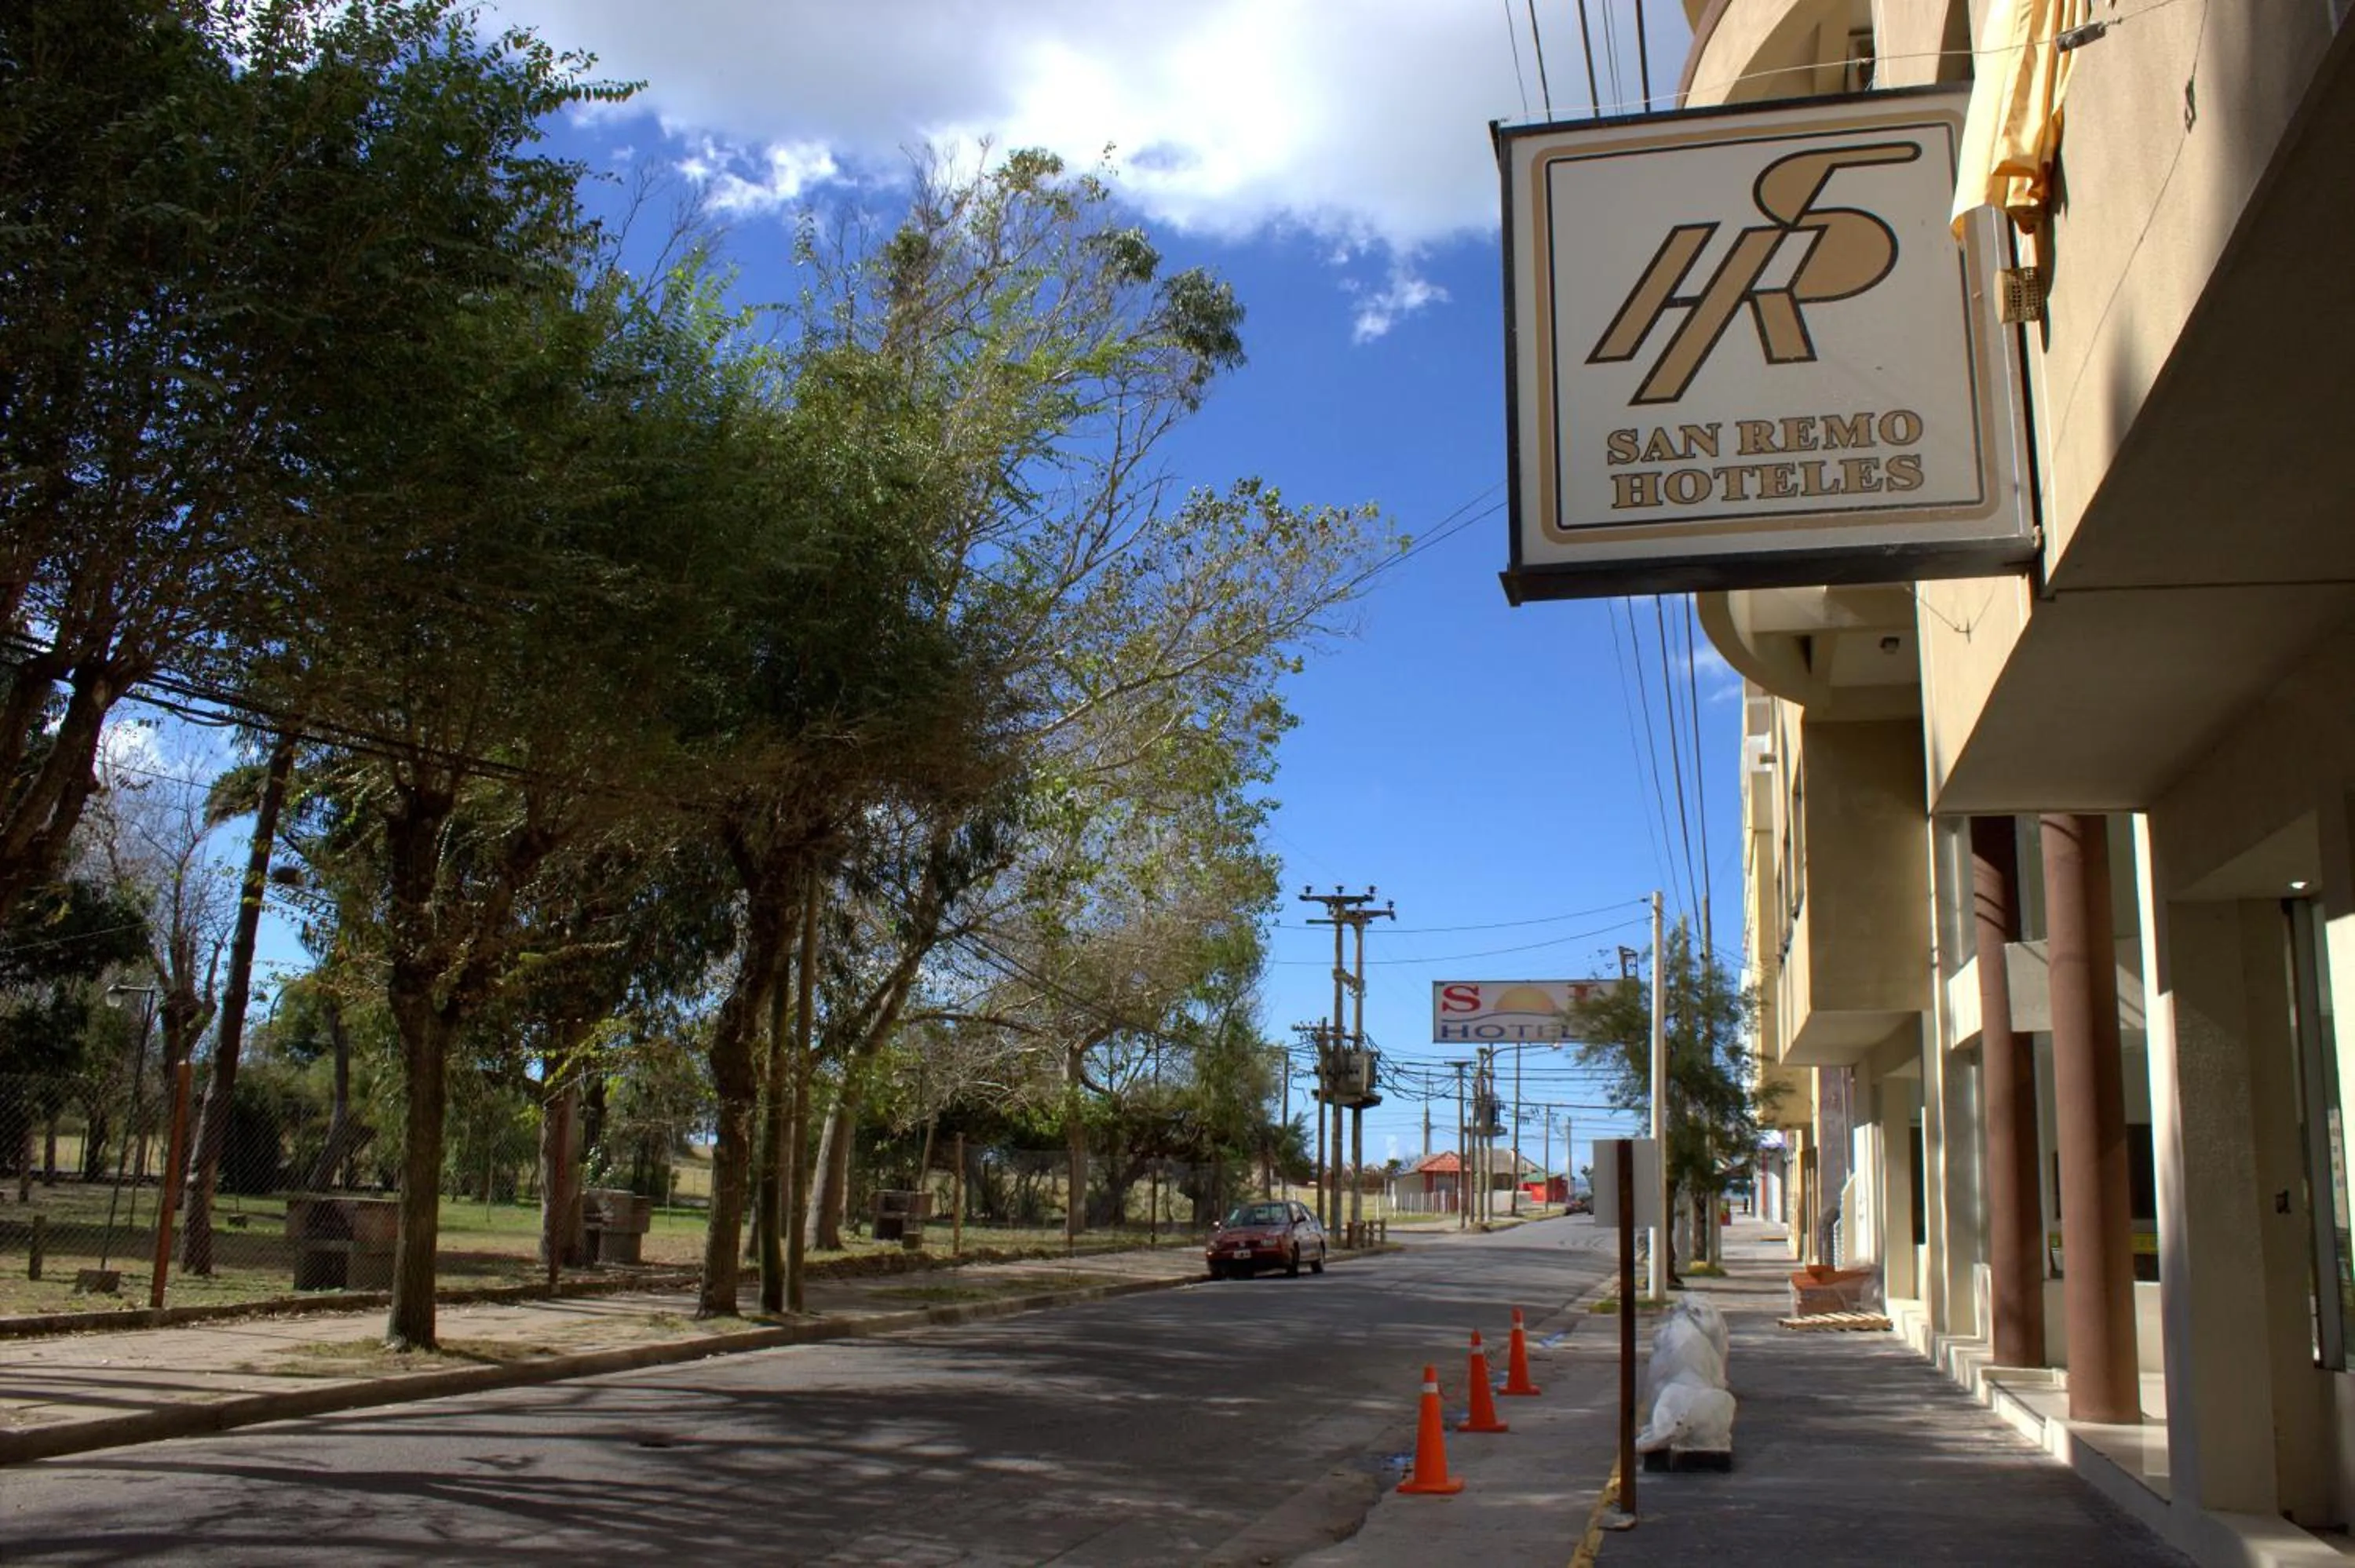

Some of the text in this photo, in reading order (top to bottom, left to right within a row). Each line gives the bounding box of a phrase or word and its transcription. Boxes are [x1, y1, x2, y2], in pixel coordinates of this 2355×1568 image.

[1607, 410, 1923, 465] SAN REMO
[1610, 454, 1924, 509] HOTELES
